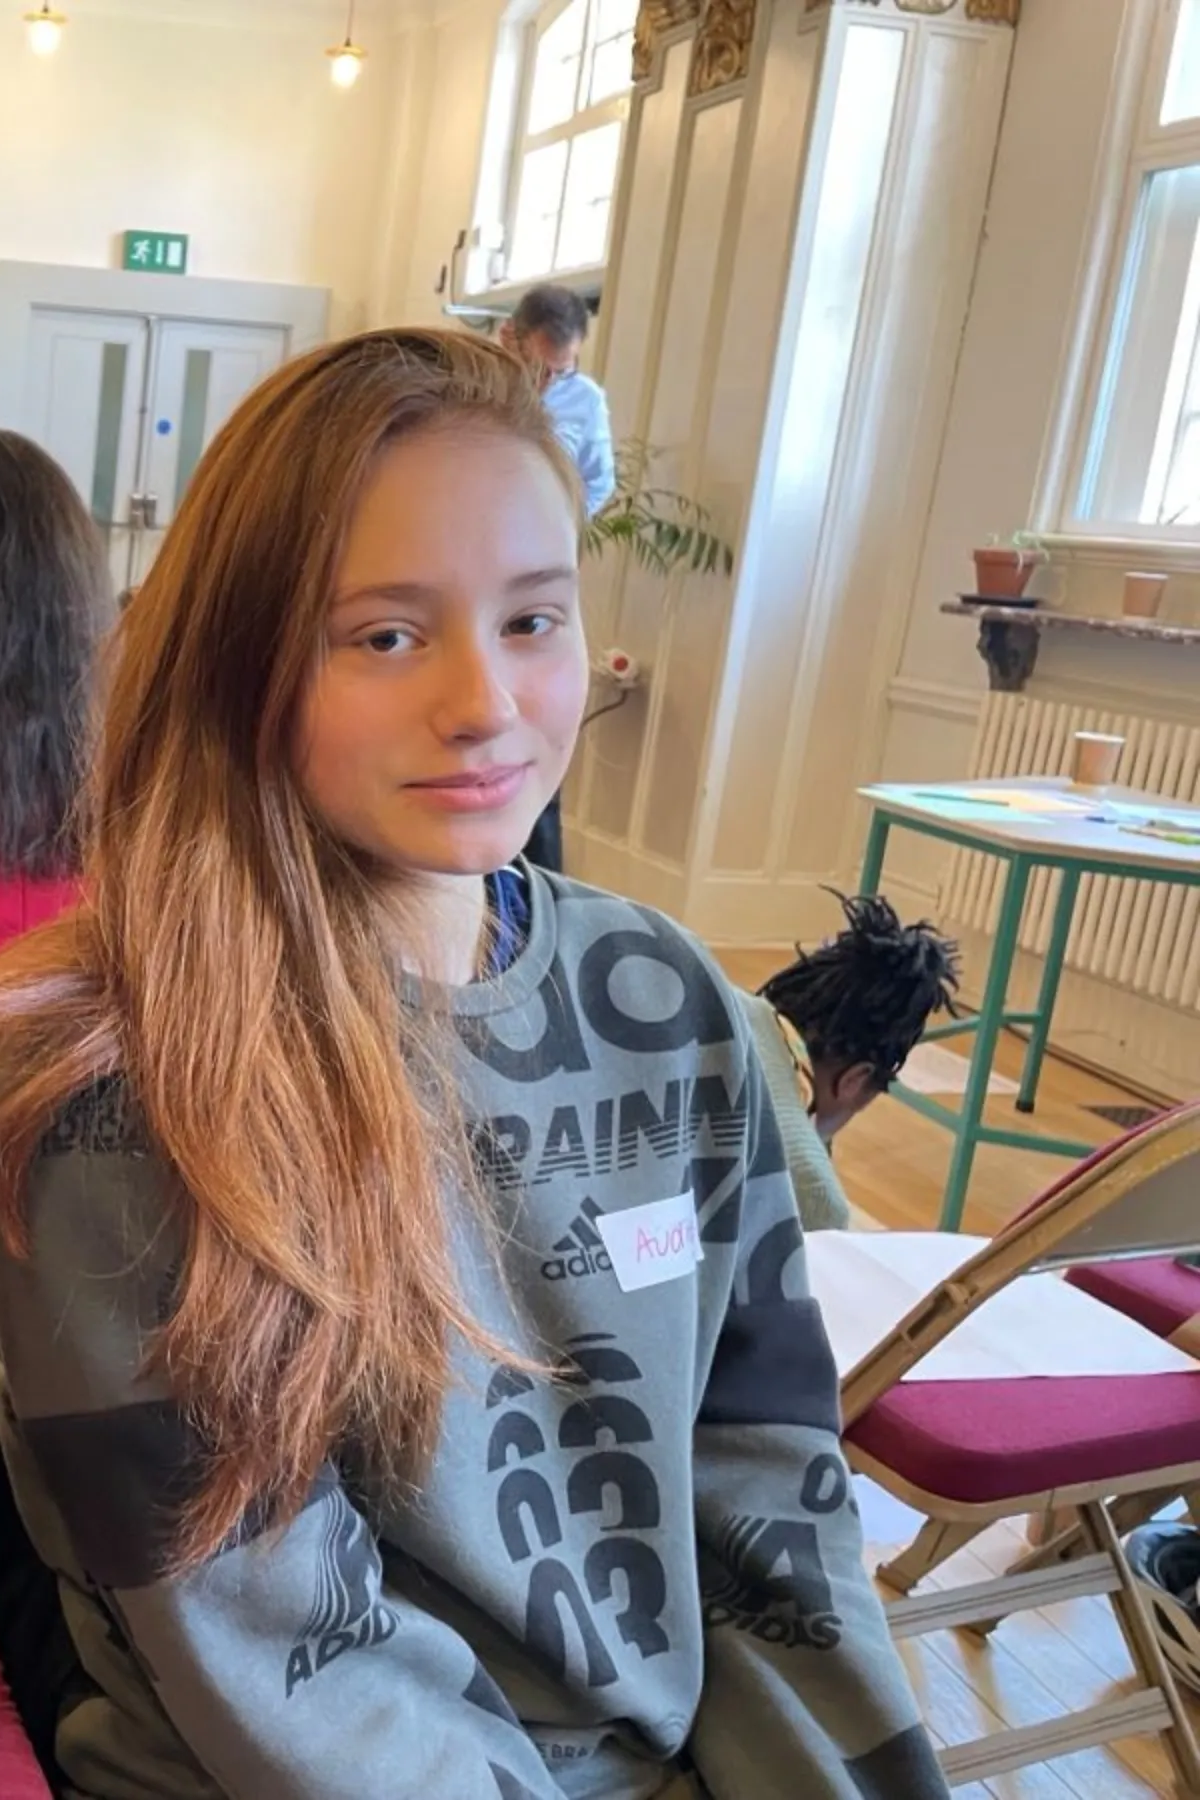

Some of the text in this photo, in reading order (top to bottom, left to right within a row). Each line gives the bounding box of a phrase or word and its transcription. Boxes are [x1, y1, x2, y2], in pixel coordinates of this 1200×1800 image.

[540, 1247, 613, 1281] adid
[285, 1603, 402, 1701] ADID
[551, 1743, 589, 1759] BRA
